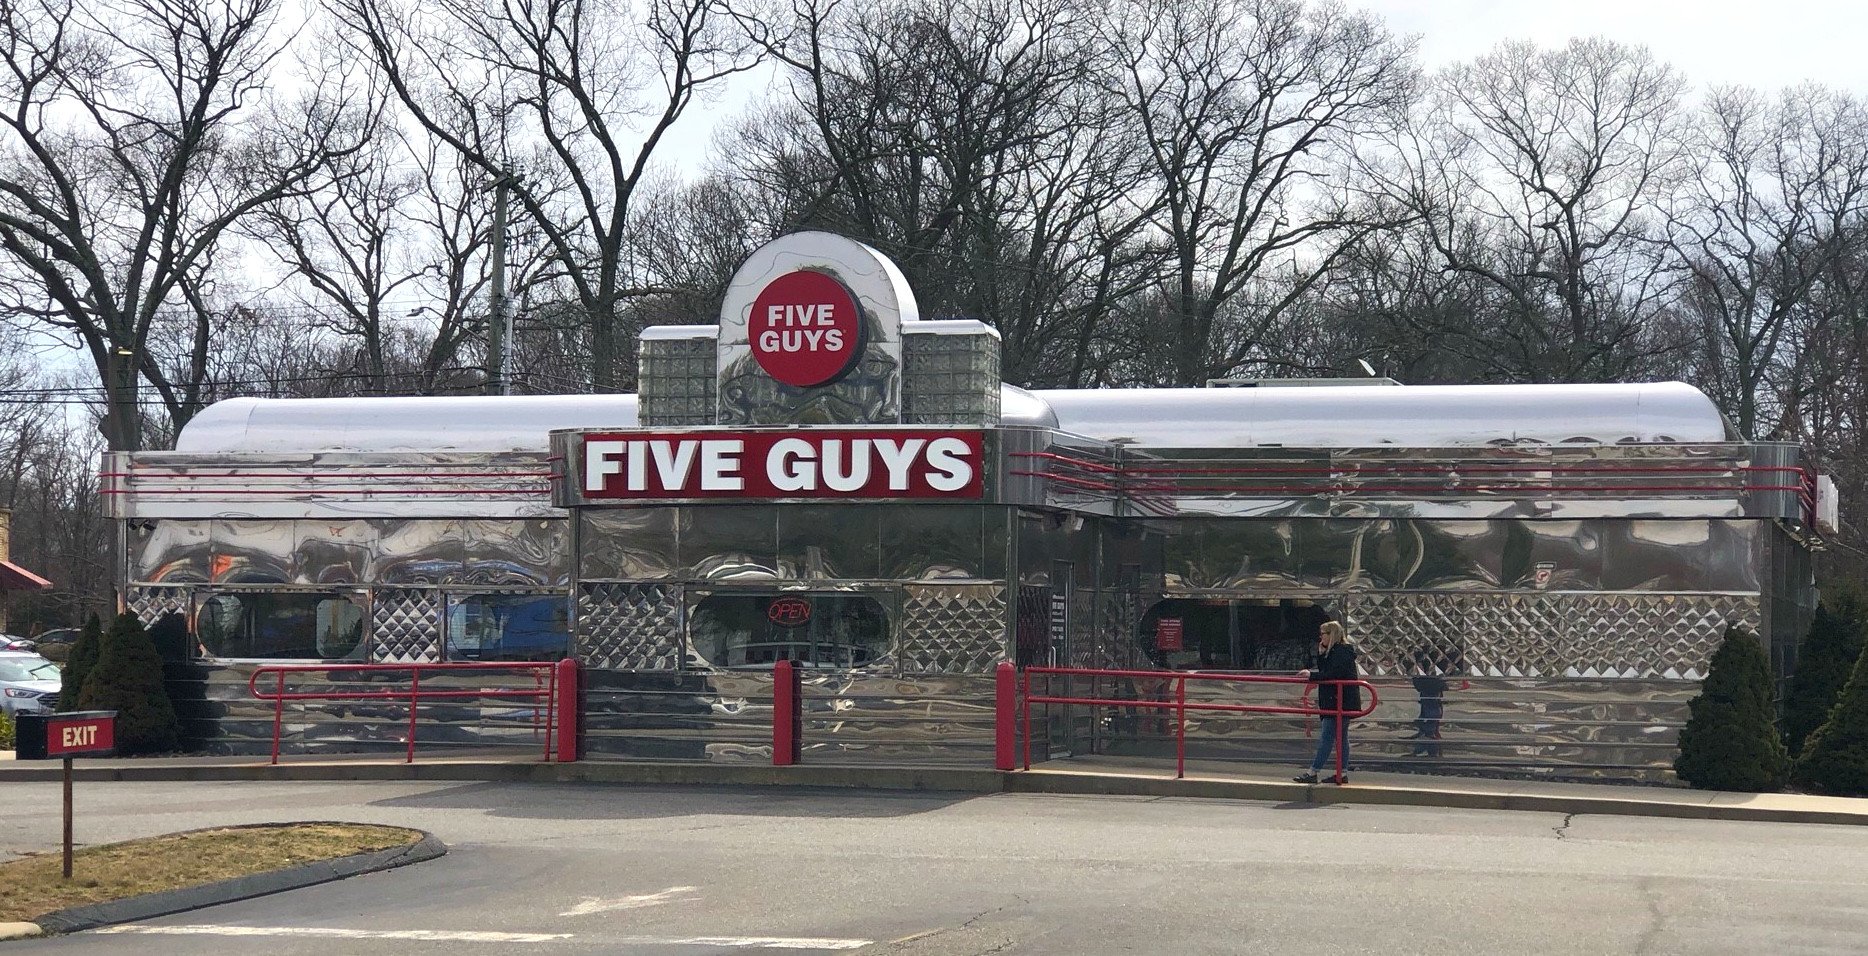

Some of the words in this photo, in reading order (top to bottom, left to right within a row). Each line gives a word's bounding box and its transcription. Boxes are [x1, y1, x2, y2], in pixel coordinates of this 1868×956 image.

[768, 304, 835, 327] FIVE
[759, 329, 844, 353] GUYS
[585, 440, 745, 491] FIVE
[766, 437, 973, 491] GUYS
[768, 603, 812, 619] OPEN
[62, 725, 98, 747] EXIT
